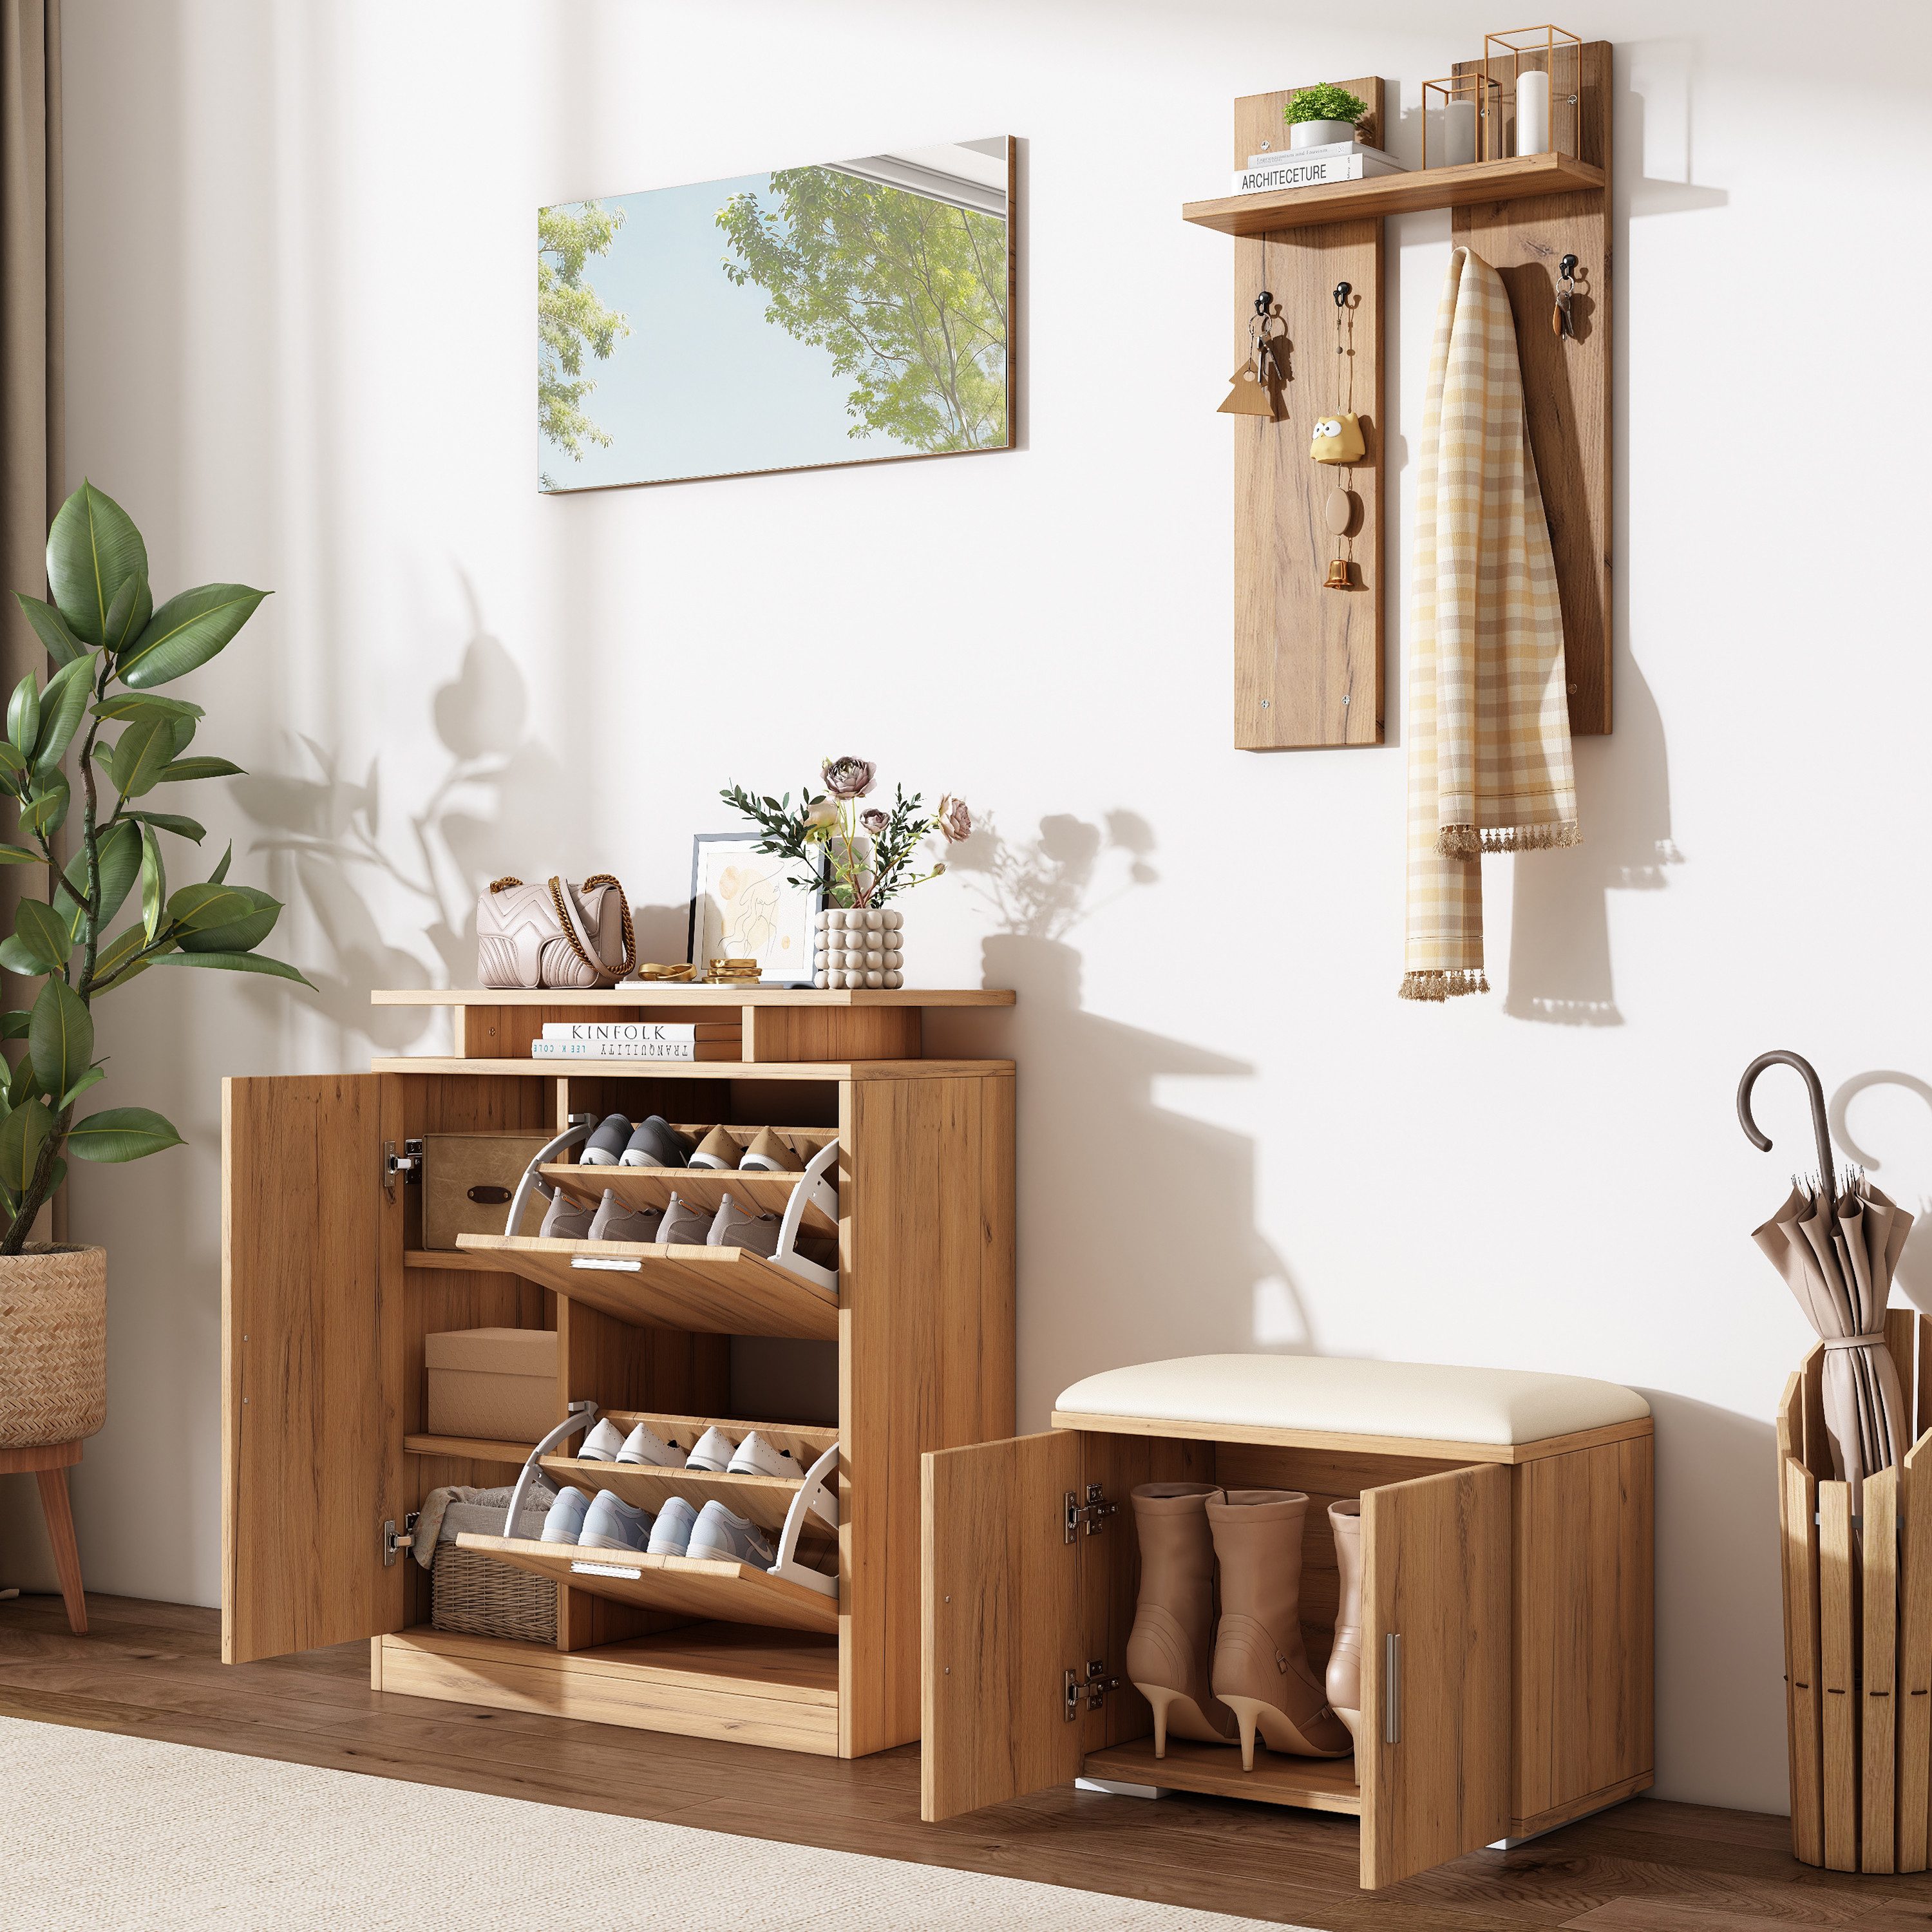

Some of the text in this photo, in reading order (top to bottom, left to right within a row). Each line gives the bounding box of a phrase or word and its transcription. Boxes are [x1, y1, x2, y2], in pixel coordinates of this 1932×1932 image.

[1242, 164, 1327, 189] ARCHITECETURE
[572, 1025, 666, 1040] KINFOLK
[533, 1044, 554, 1052] COLE
[571, 1045, 585, 1053] LEE
[600, 1043, 688, 1056] TRANQUILITY
